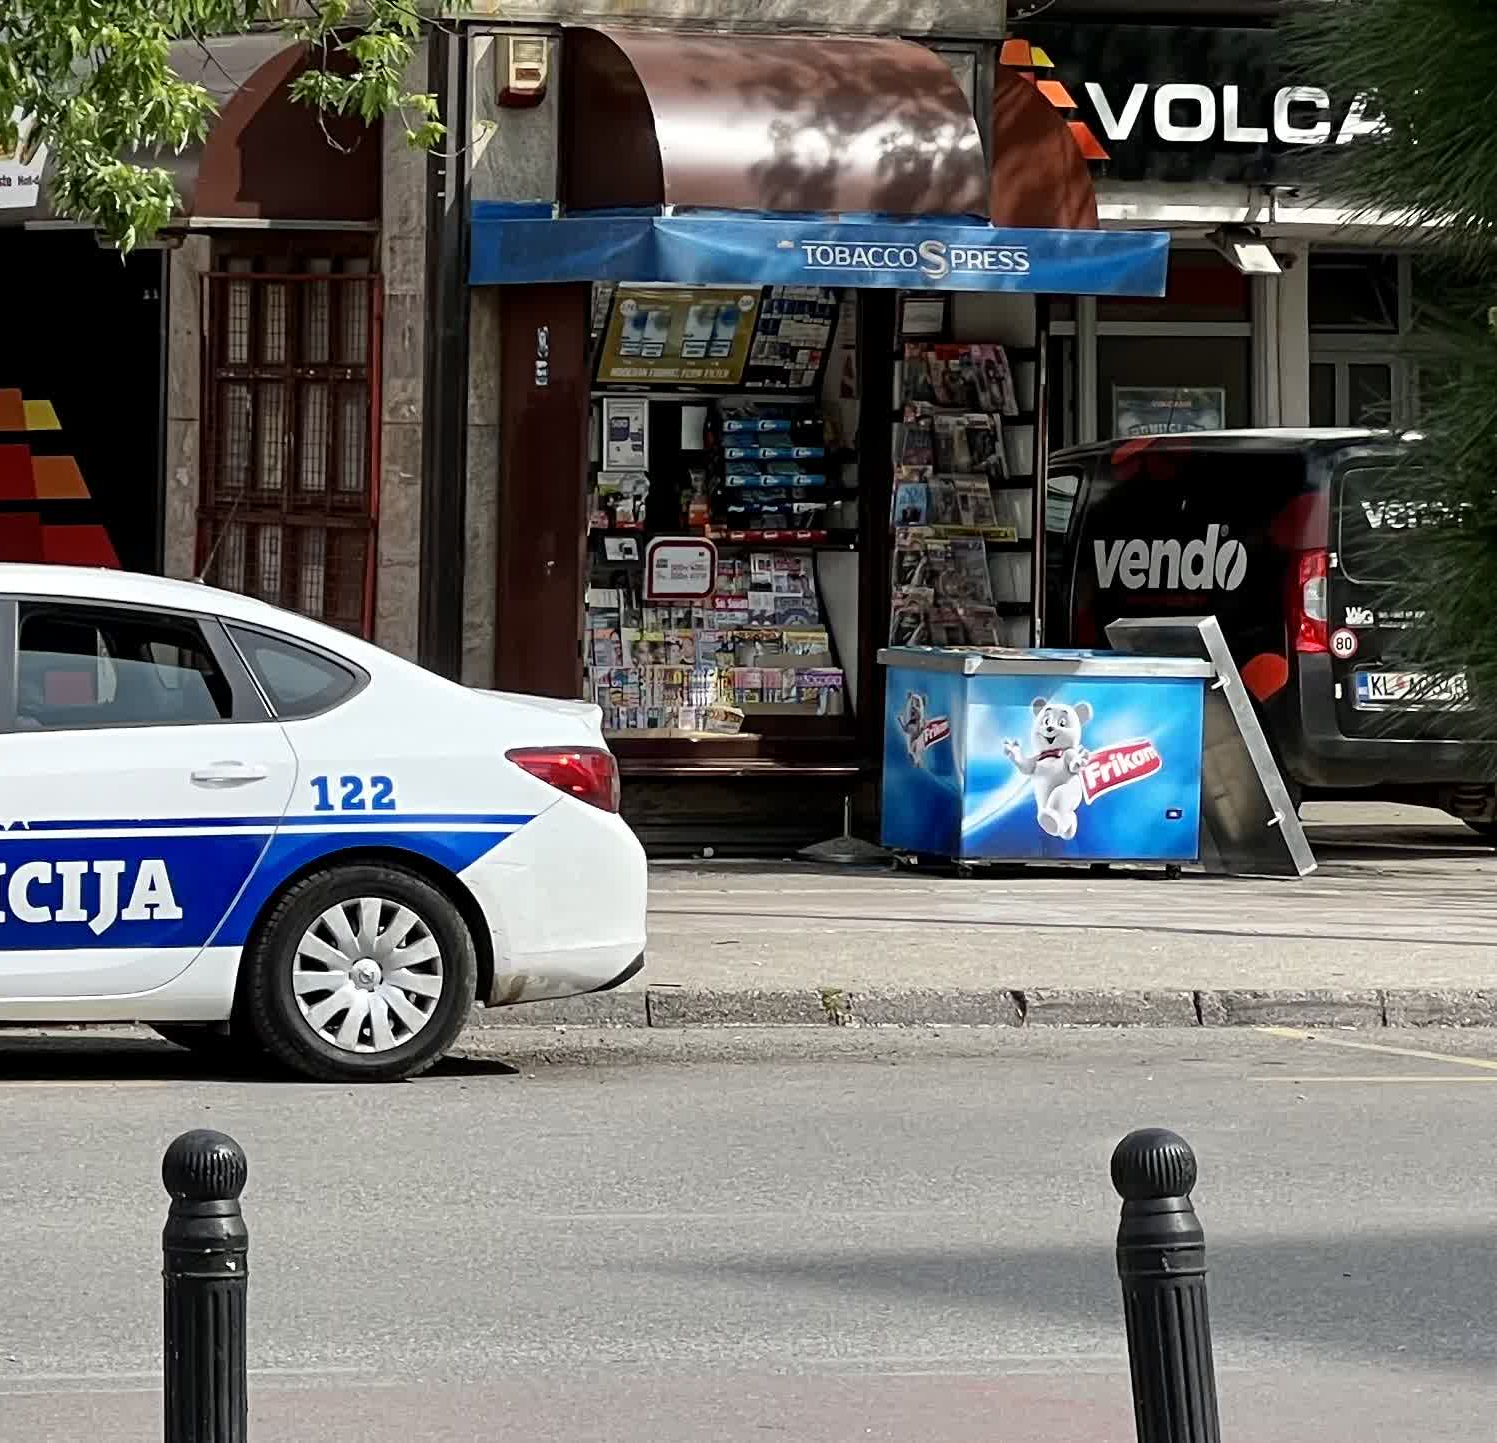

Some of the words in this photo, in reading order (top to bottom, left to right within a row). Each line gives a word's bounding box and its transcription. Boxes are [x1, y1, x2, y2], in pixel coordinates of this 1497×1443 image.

[1084, 82, 1395, 144] VOLCA
[802, 245, 918, 268] TOBACCO
[950, 249, 1030, 271] PRESS
[1094, 524, 1248, 591] vendo
[1335, 637, 1352, 649] 80
[309, 775, 397, 811] 122
